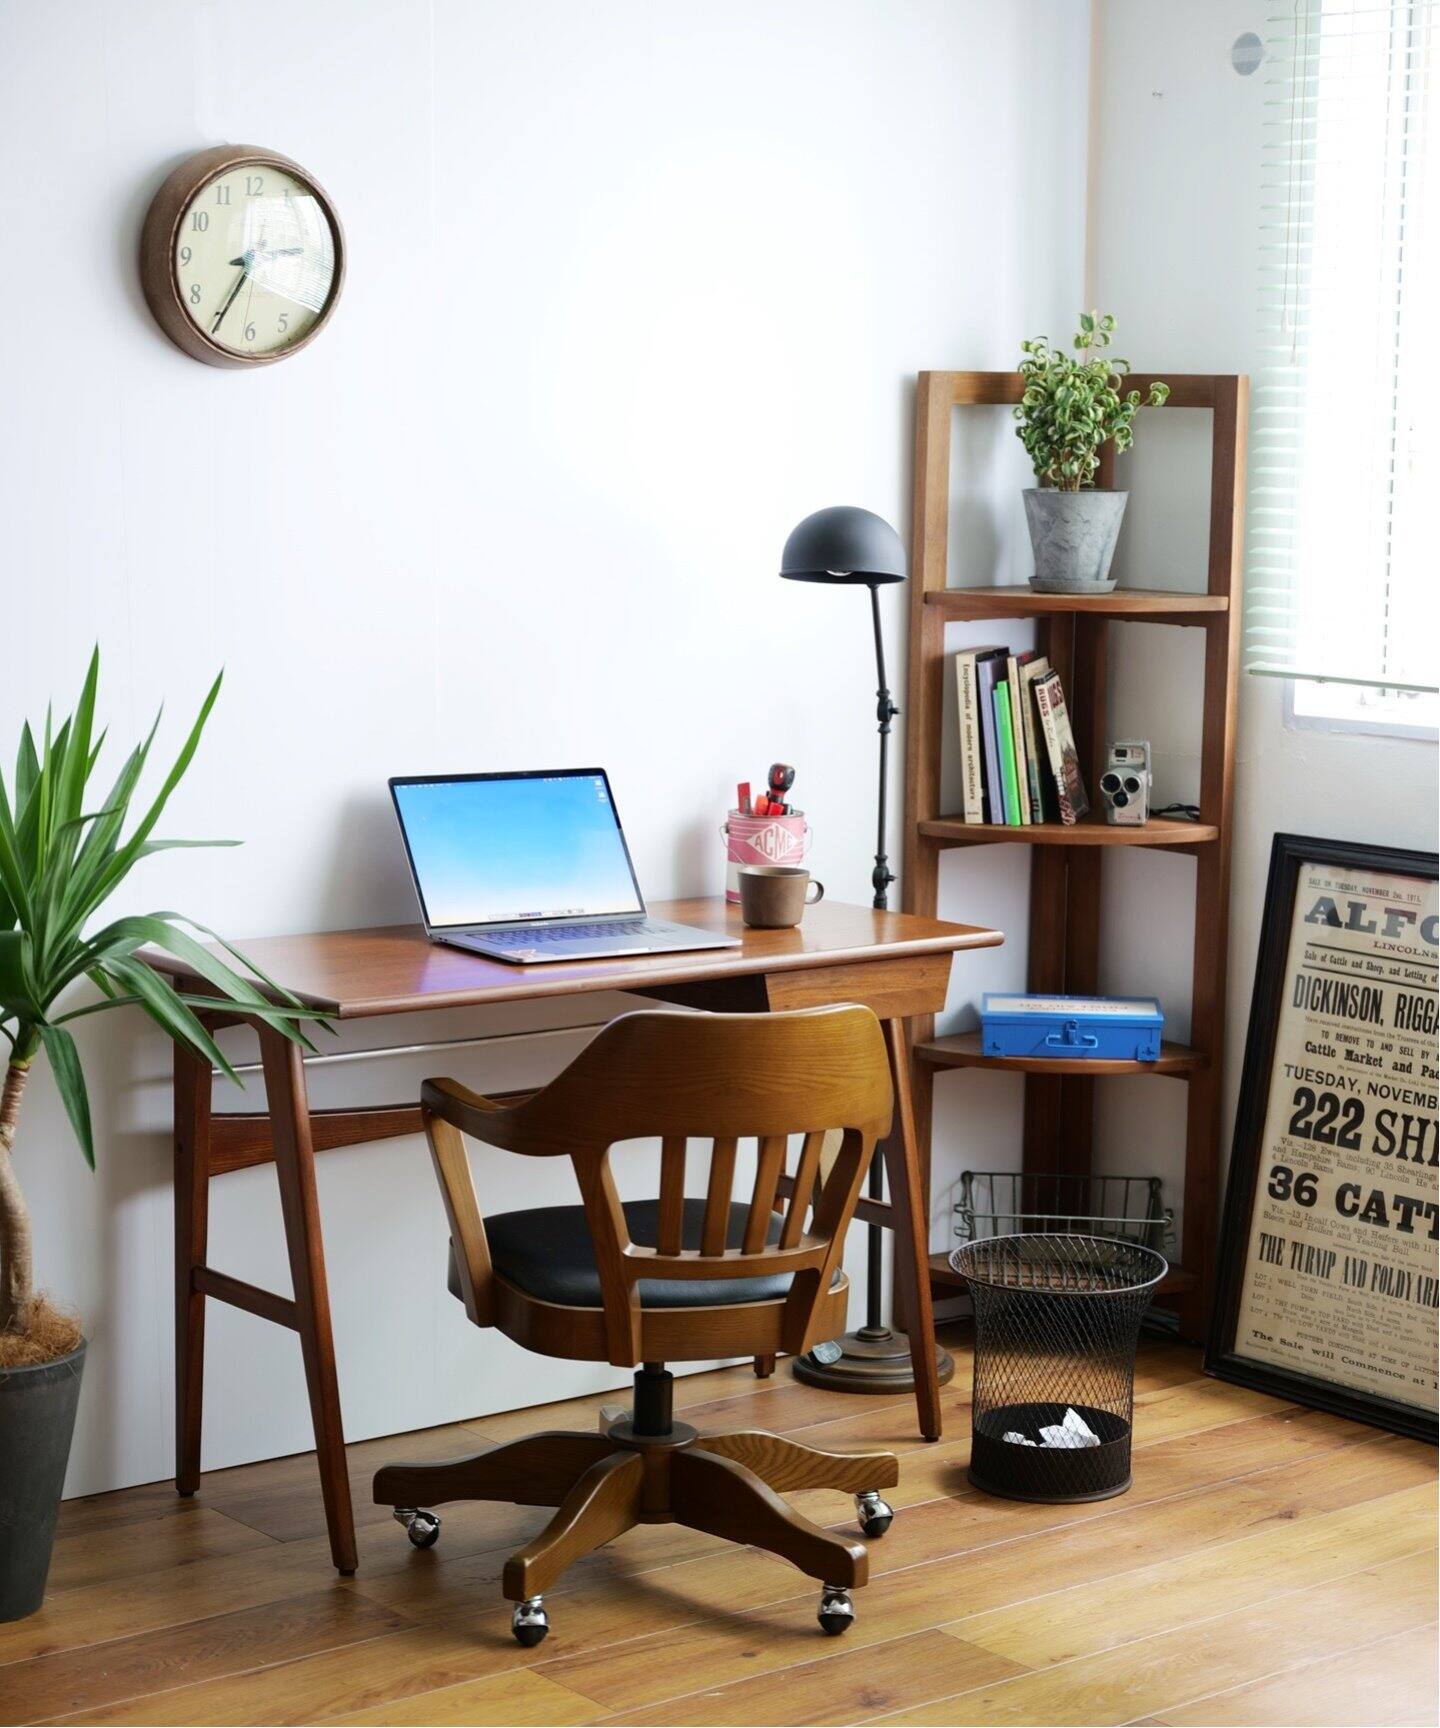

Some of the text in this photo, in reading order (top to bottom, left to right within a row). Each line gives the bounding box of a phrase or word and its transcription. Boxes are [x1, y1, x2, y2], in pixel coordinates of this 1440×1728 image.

[215, 185, 231, 205] 11
[246, 177, 264, 196] 12
[191, 211, 209, 232] 10
[180, 247, 192, 267] 9
[190, 284, 201, 304] 8
[244, 322, 256, 341] 6
[277, 314, 288, 333] 5
[963, 664, 971, 712] Encyclopedia
[1037, 688, 1049, 717] RUGS
[965, 713, 972, 721] of
[966, 724, 974, 751] modern
[755, 826, 793, 859] ACME
[1362, 887, 1389, 898] NOVEMBER
[1304, 950, 1317, 961] Sale
[1320, 954, 1328, 963] of
[1330, 955, 1347, 967] Cattle
[1351, 958, 1362, 969] and
[1389, 966, 1400, 976] and
[1404, 968, 1428, 983] Letting
[1431, 973, 1438, 983] of
[1305, 1040, 1337, 1058] Cattle
[1344, 1048, 1383, 1068] Market
[1392, 1061, 1413, 1075] and
[1321, 1030, 1329, 1040] TO
[1335, 1032, 1360, 1046] REMOVE
[1366, 1039, 1375, 1049] TO
[1381, 1042, 1393, 1053] AND
[1400, 1046, 1414, 1057] SELL
[1421, 1049, 1430, 1060] BY
[1284, 1064, 1361, 1096] TUESDAY,
[1288, 1086, 1365, 1151] 222
[1280, 1154, 1309, 1168] Lincoln
[1268, 1165, 1320, 1208] 36
[1380, 1170, 1410, 1184] Lincoln
[1288, 1220, 1303, 1228] and
[1336, 1232, 1351, 1241] and
[1357, 1234, 1388, 1251] Yearling
[1353, 1227, 1367, 1236] and
[1402, 1240, 1420, 1250] with
[1259, 1232, 1286, 1266] THE
[1290, 1241, 1337, 1279] TURNIP
[1340, 1255, 1368, 1288] AND
[1252, 1329, 1274, 1342] The
[1280, 1337, 1304, 1351] Sale
[1311, 1348, 1335, 1360] will
[1341, 1356, 1405, 1380] Commence
[1412, 1377, 1425, 1386] at
